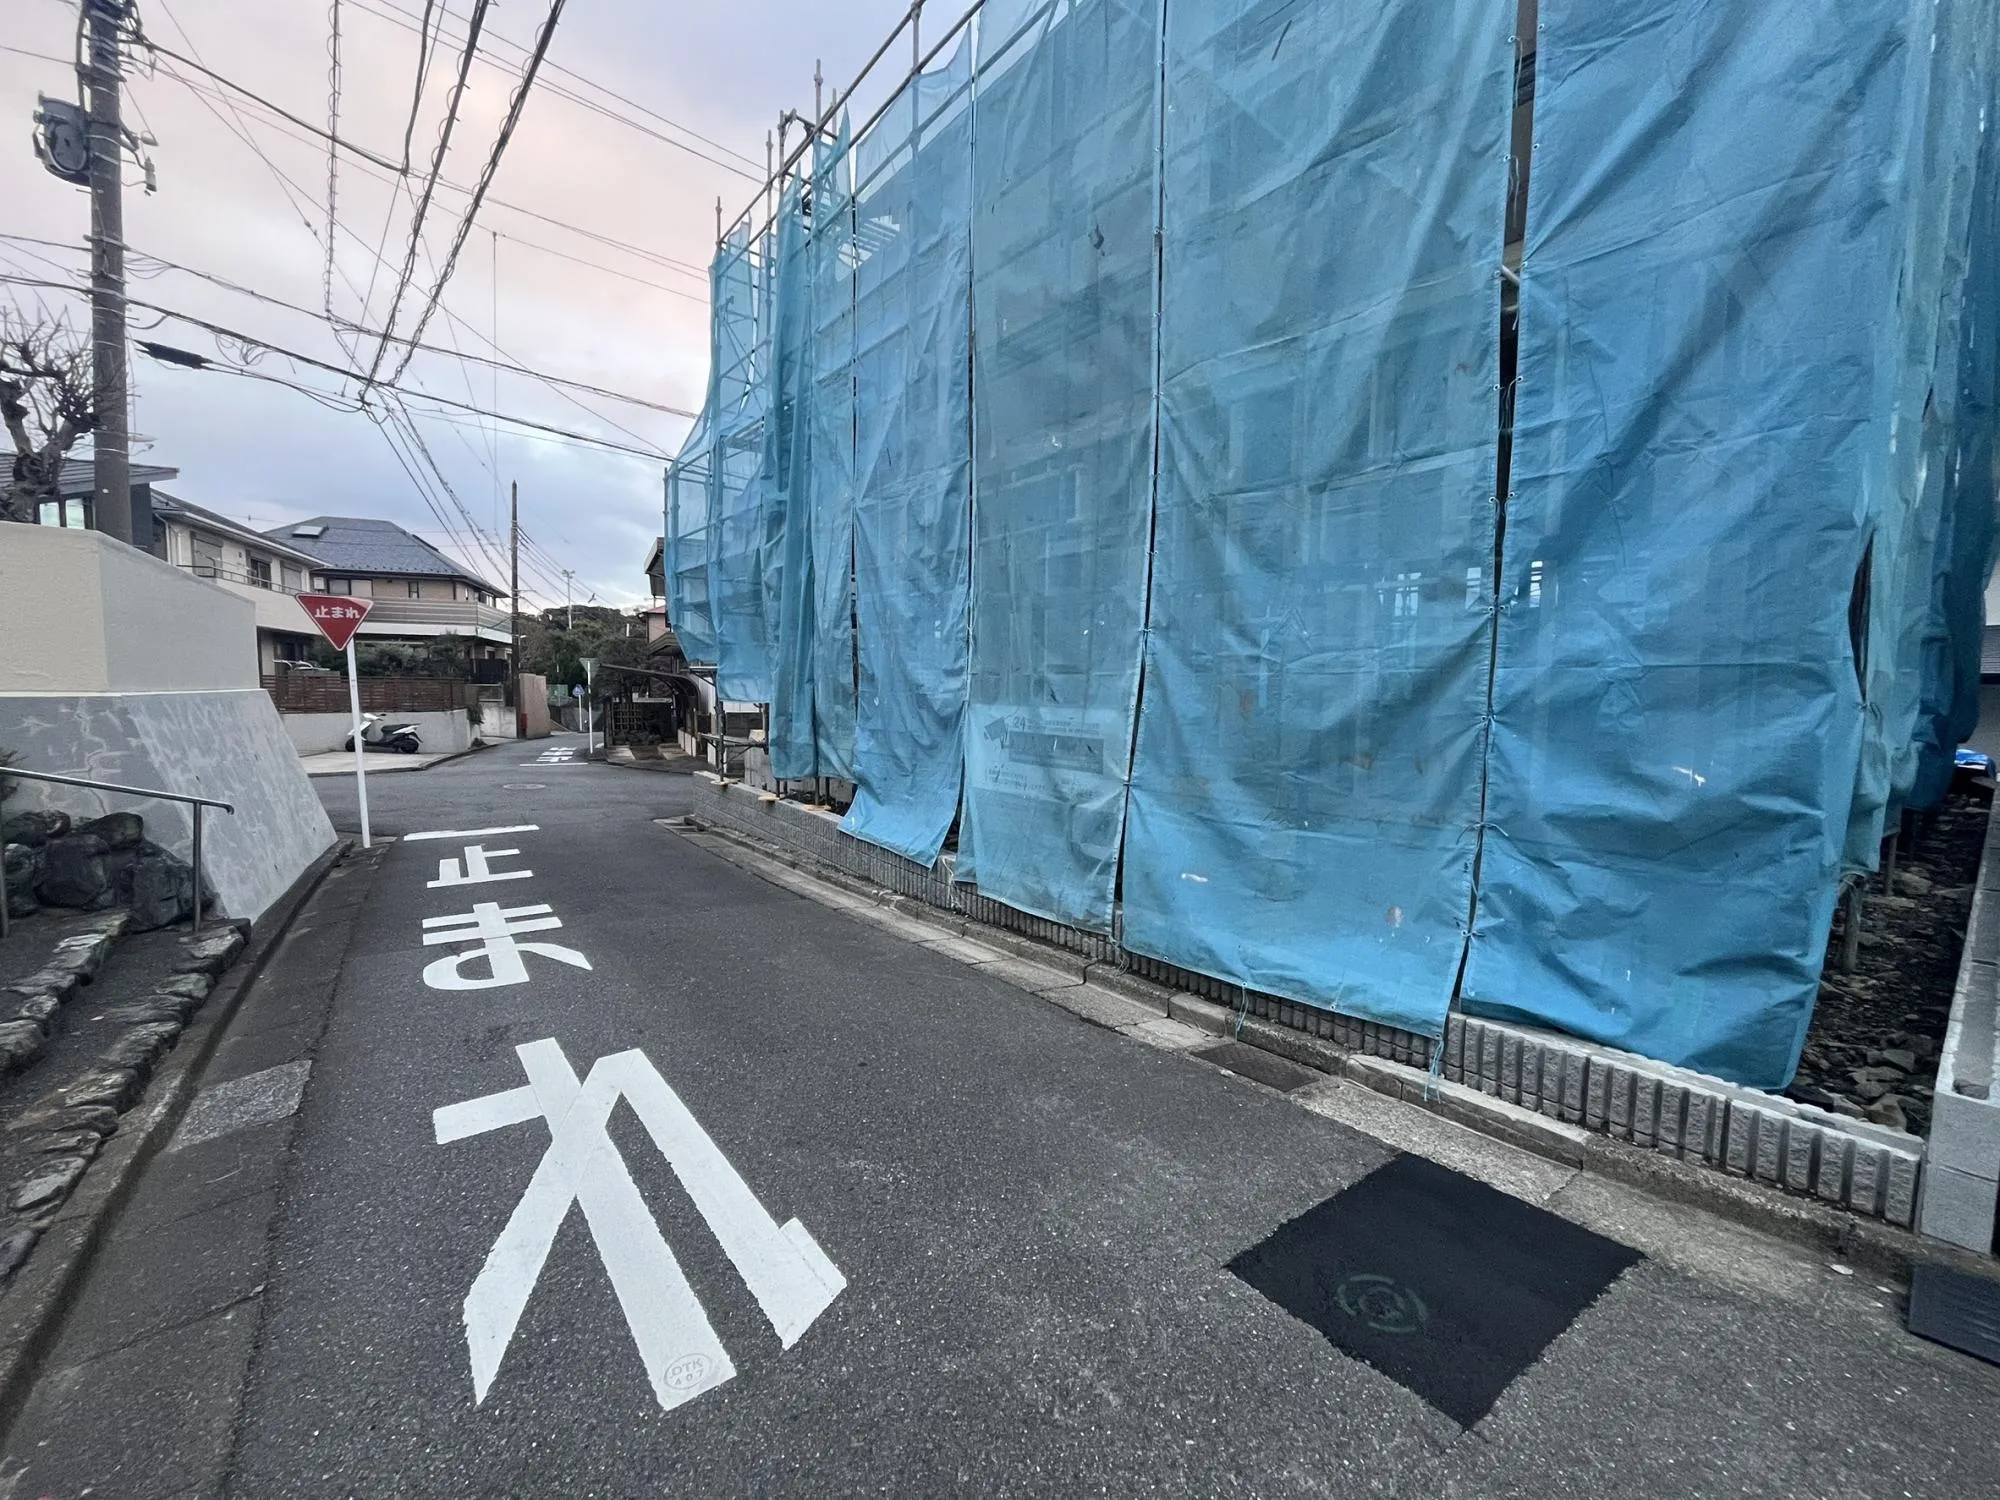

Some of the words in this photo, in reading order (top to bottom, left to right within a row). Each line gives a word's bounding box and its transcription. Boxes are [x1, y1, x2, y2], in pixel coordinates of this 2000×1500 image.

[314, 605, 361, 619] 止まれ
[421, 845, 847, 1406] 止まれ
